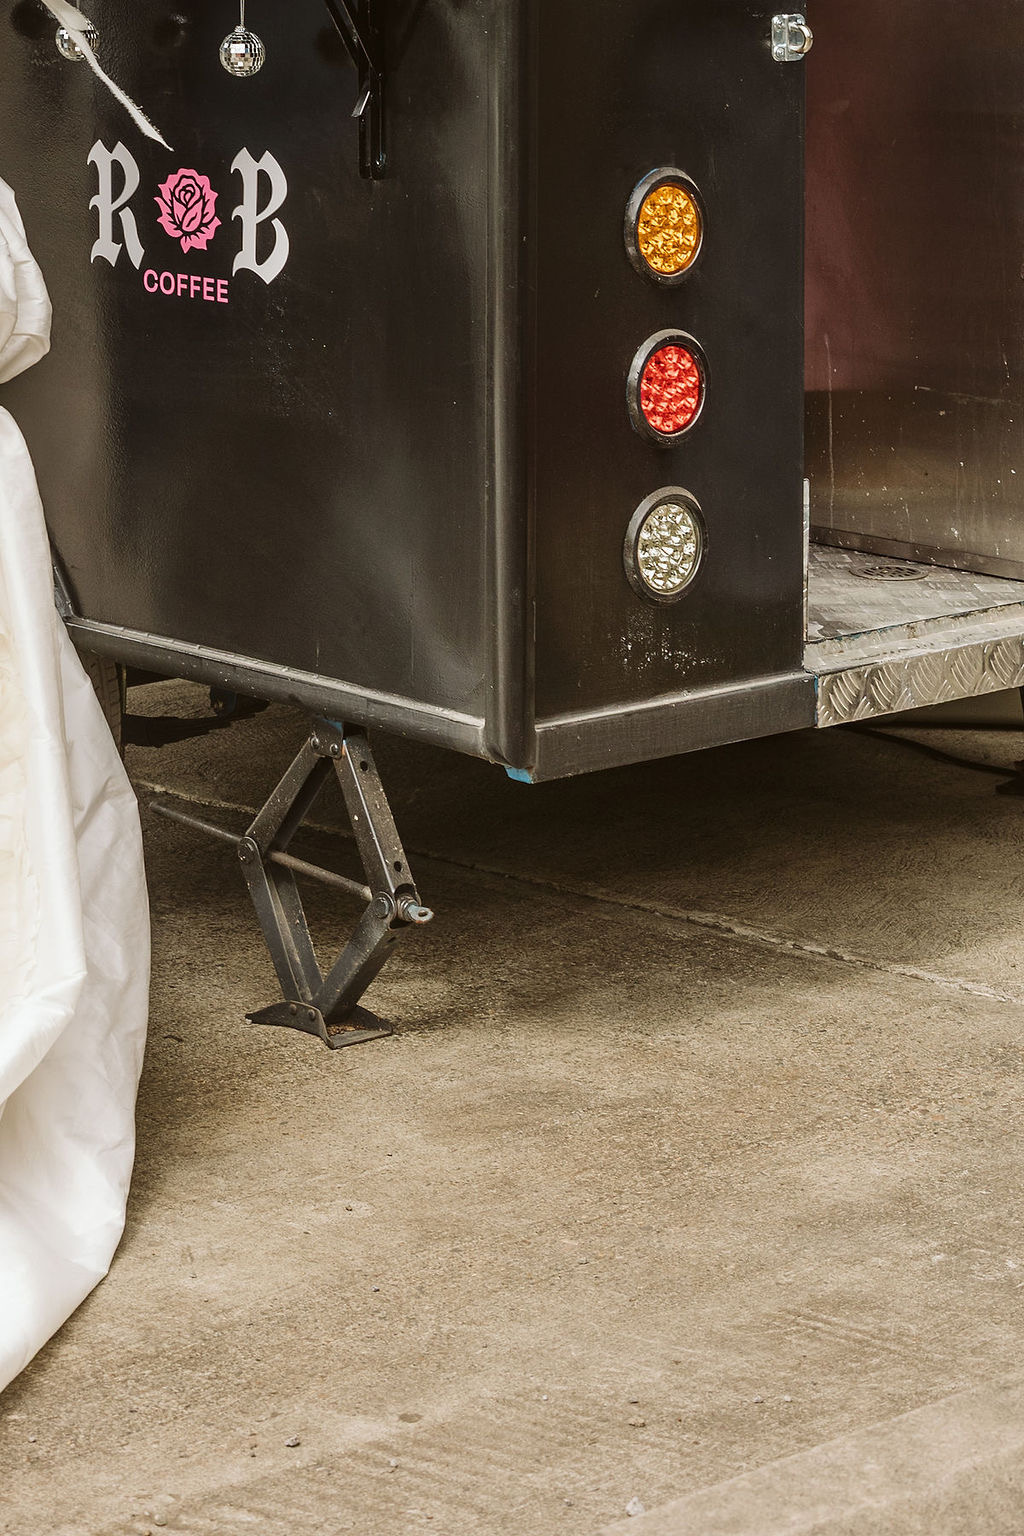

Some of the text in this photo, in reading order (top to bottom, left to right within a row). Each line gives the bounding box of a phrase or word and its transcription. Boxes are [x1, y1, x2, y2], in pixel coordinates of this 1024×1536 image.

[86, 138, 290, 285] R B
[143, 268, 229, 304] COFFEE
